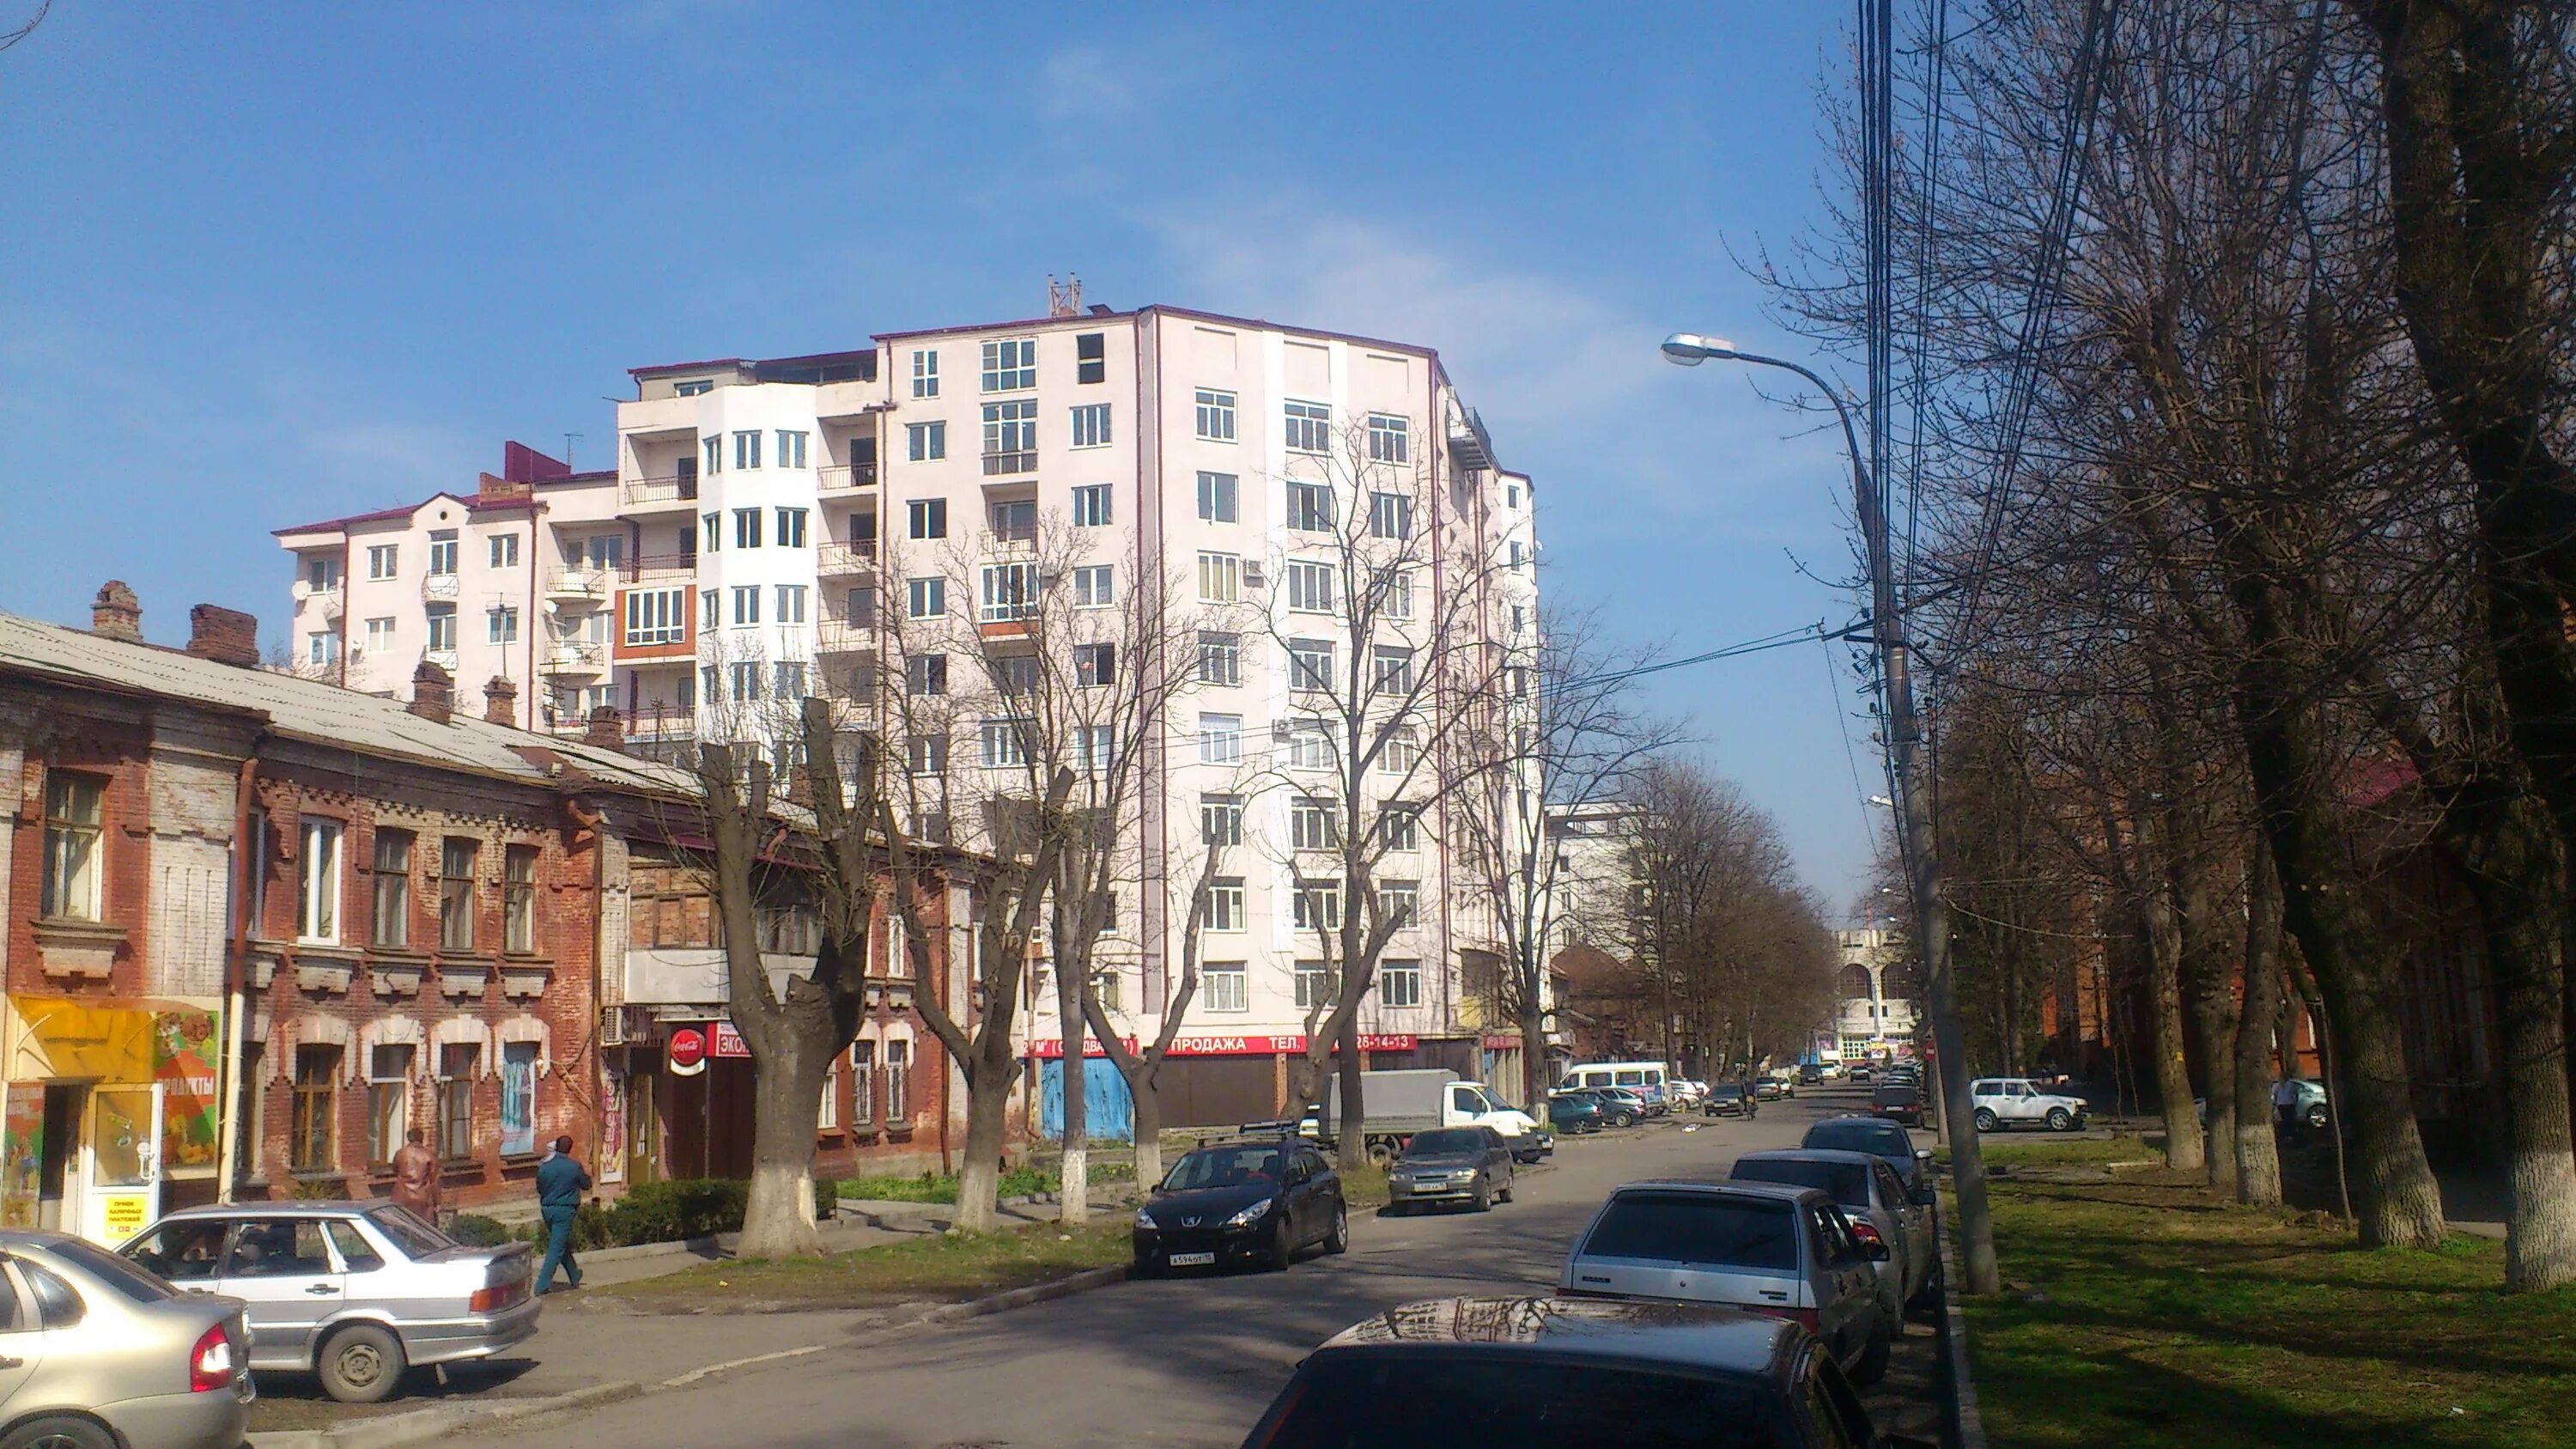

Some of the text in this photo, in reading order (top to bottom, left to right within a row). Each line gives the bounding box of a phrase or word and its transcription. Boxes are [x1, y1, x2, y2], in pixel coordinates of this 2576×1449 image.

[720, 1036, 750, 1053] ЭКО
[1170, 1037, 1247, 1053] ПРОДАЖА
[1268, 1036, 1301, 1050] ТЕЛ.
